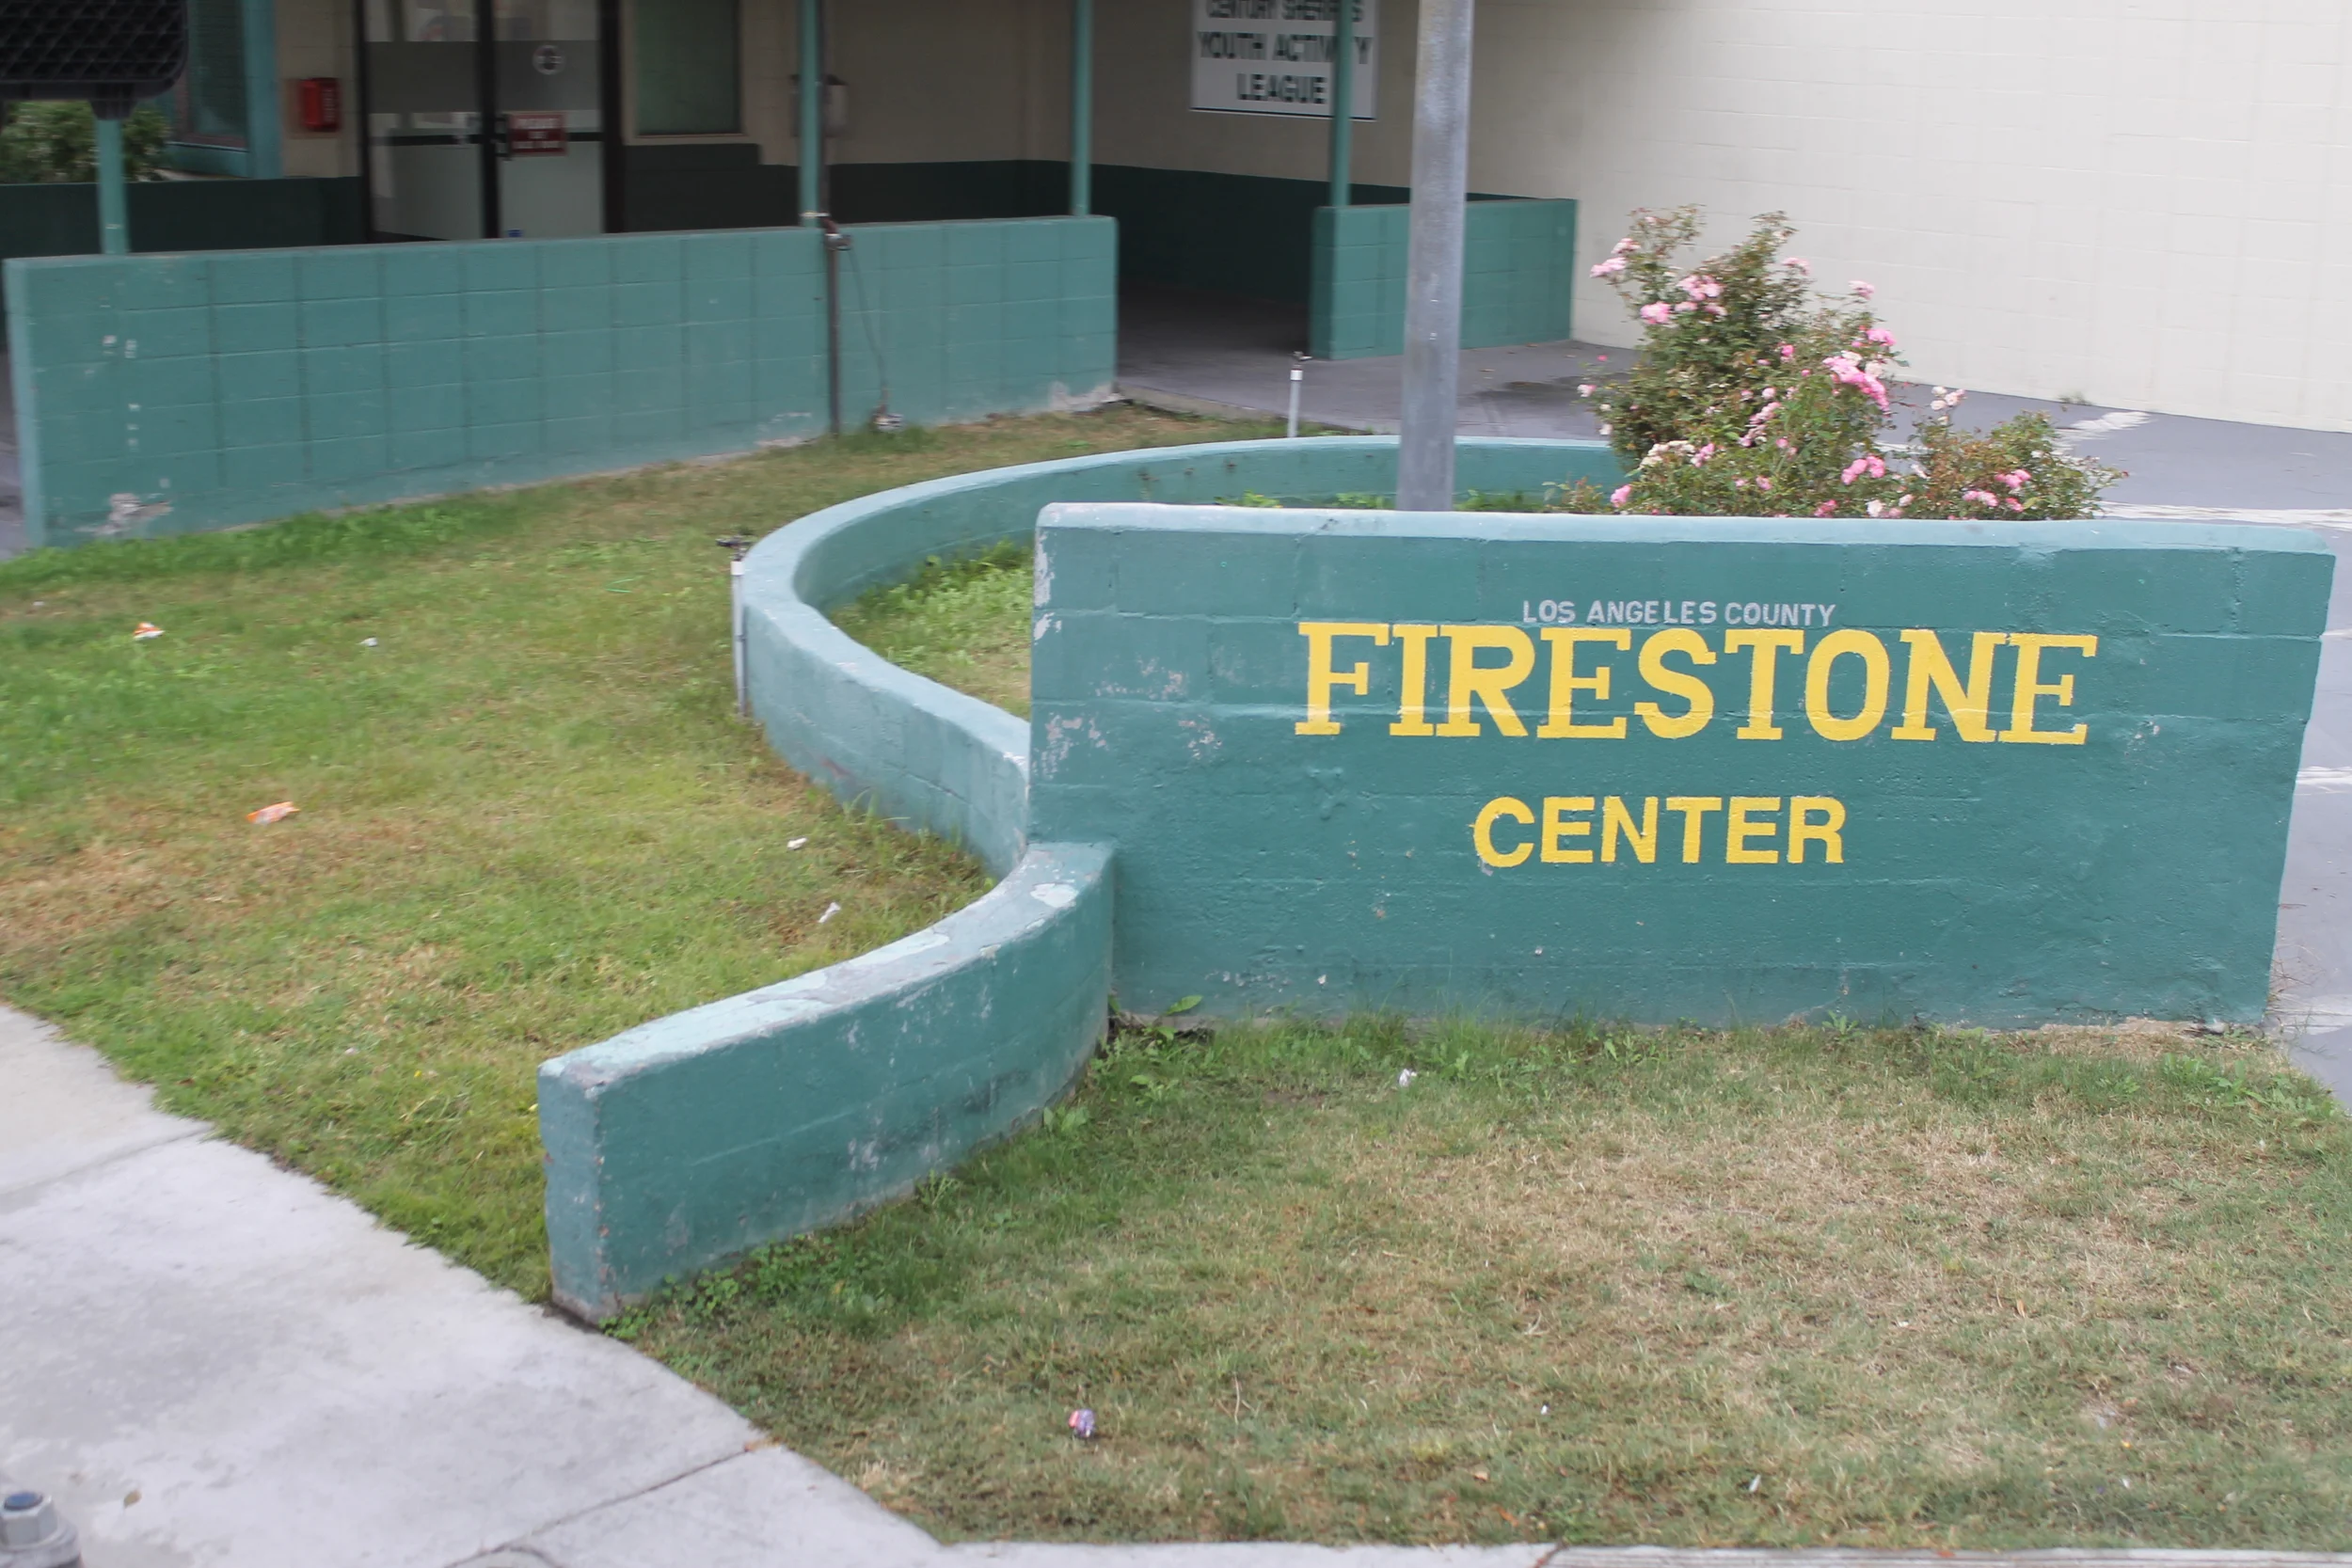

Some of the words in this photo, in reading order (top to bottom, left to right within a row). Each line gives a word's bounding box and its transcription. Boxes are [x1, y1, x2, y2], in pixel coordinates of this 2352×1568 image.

[1198, 30, 1268, 60] YOUTH
[1272, 33, 1374, 64] ACTIVY
[1236, 72, 1327, 103] LEAGUE
[1522, 599, 1576, 624] LOS
[1585, 600, 1718, 625] ANGELES
[1724, 602, 1837, 627] COUNTY
[1295, 622, 2098, 745] FIRESTONE
[1471, 796, 1847, 867] CENTER
